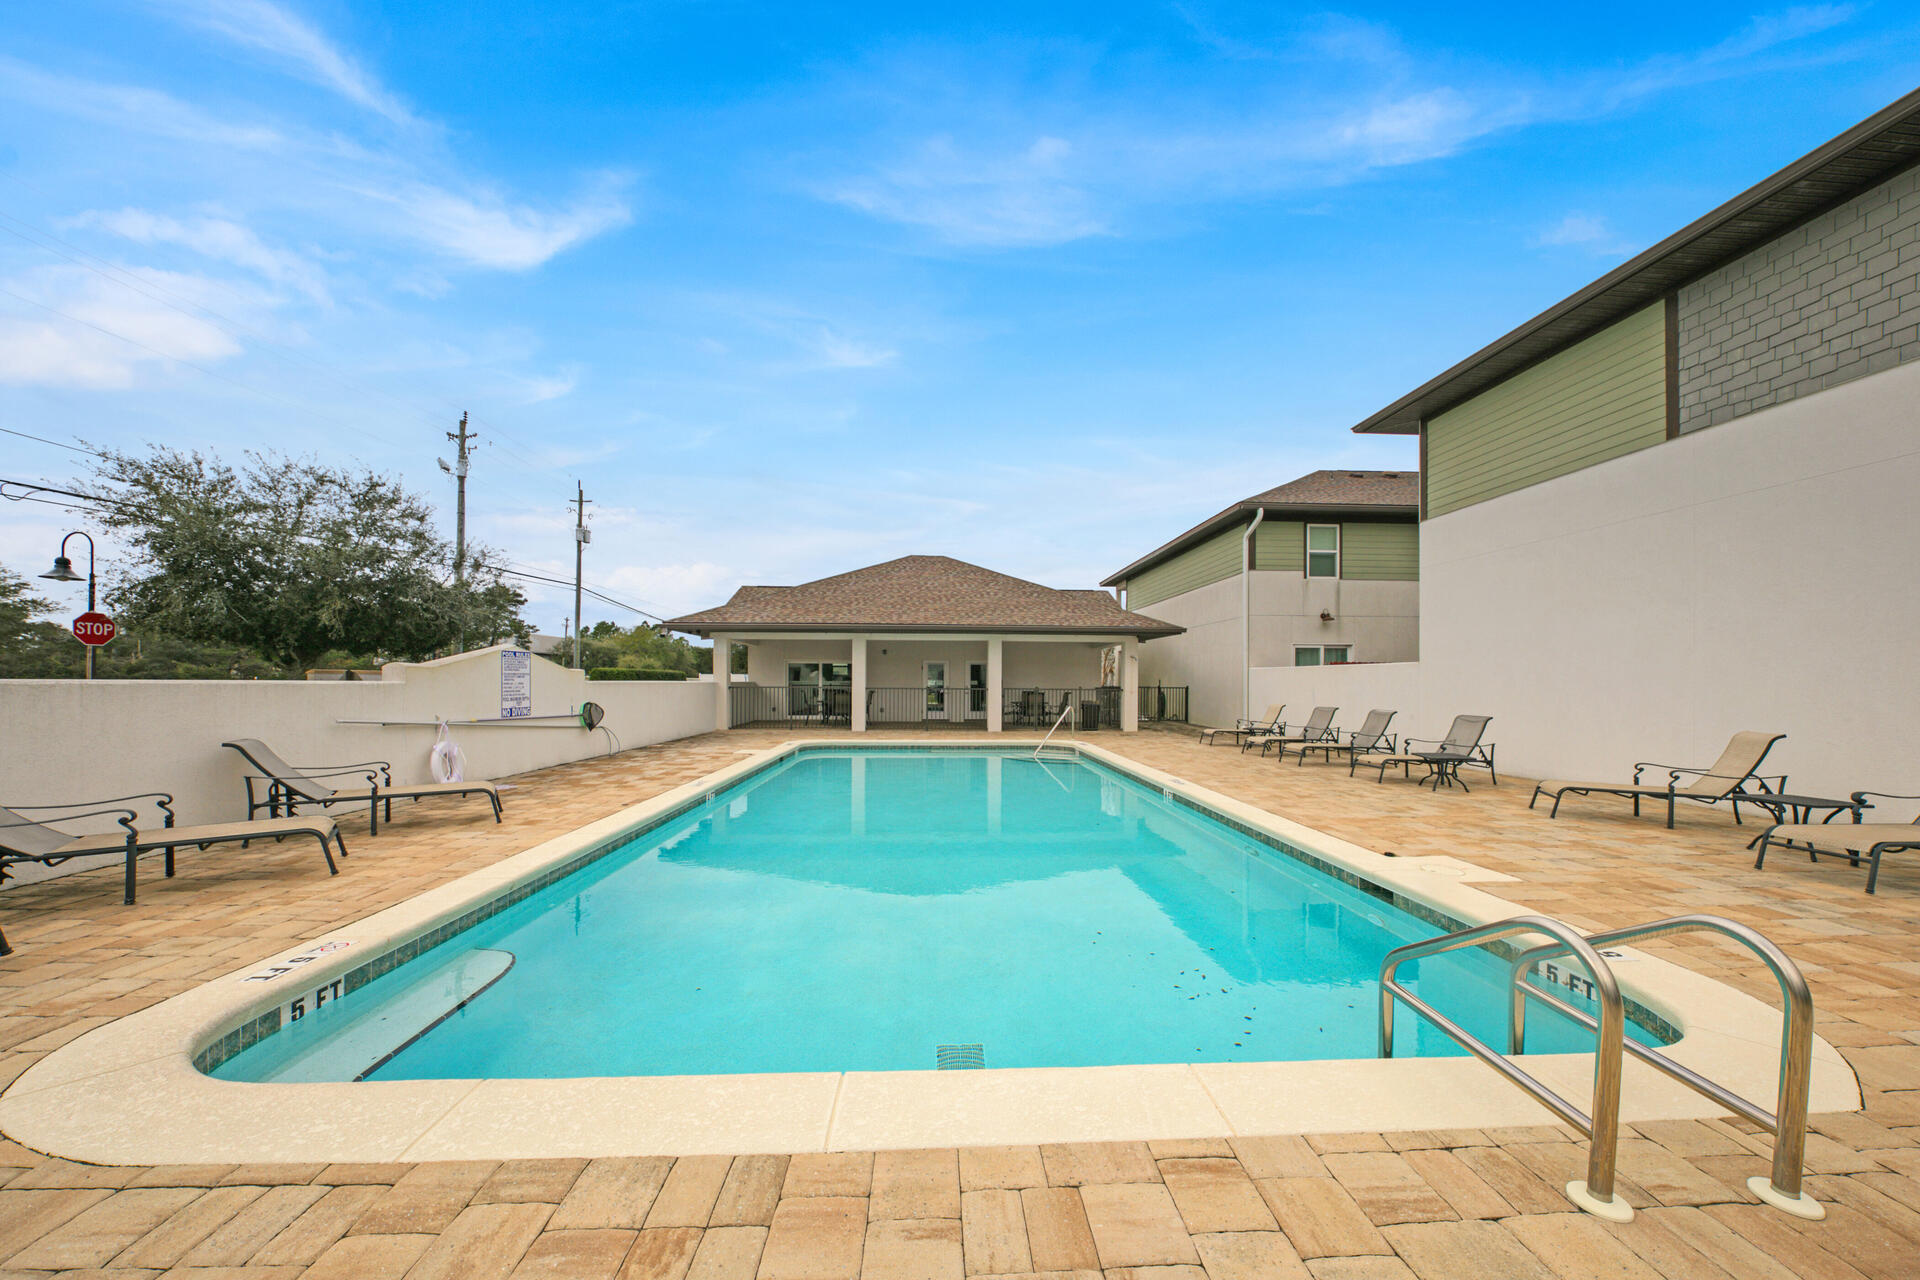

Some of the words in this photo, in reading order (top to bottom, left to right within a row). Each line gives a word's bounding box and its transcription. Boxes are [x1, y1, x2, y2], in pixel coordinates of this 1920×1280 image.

[76, 621, 114, 636] STOP
[503, 707, 511, 717] NO
[512, 706, 531, 716] DIVING
[1546, 962, 1559, 984] 5
[1568, 972, 1595, 1001] FT
[291, 996, 305, 1022] 5
[316, 978, 342, 1010] FT
